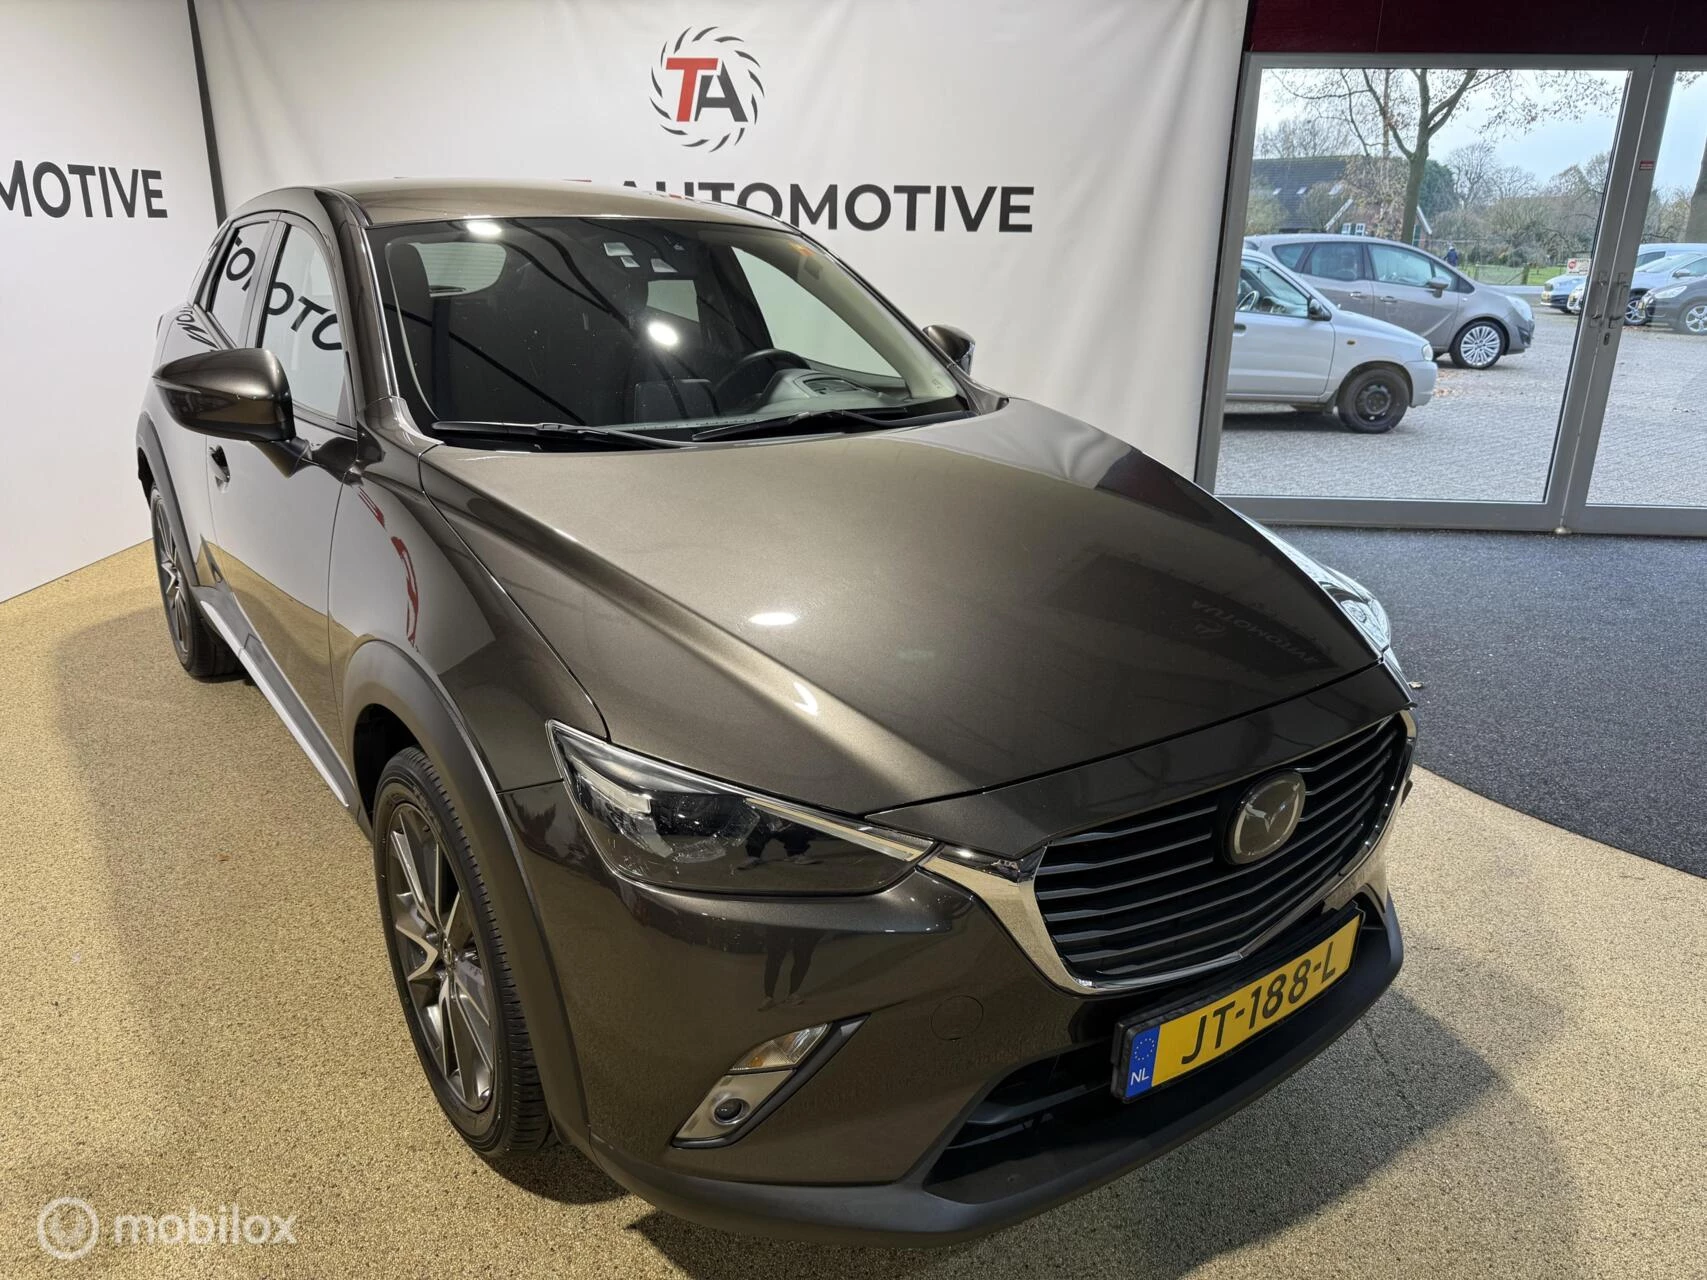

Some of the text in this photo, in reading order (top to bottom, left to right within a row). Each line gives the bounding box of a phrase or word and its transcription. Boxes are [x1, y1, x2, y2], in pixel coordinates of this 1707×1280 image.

[665, 57, 749, 122] TA
[623, 180, 1035, 233] TOMOTIVE
[1181, 941, 1337, 1065] JT-188-L
[1130, 1067, 1150, 1086] NL
